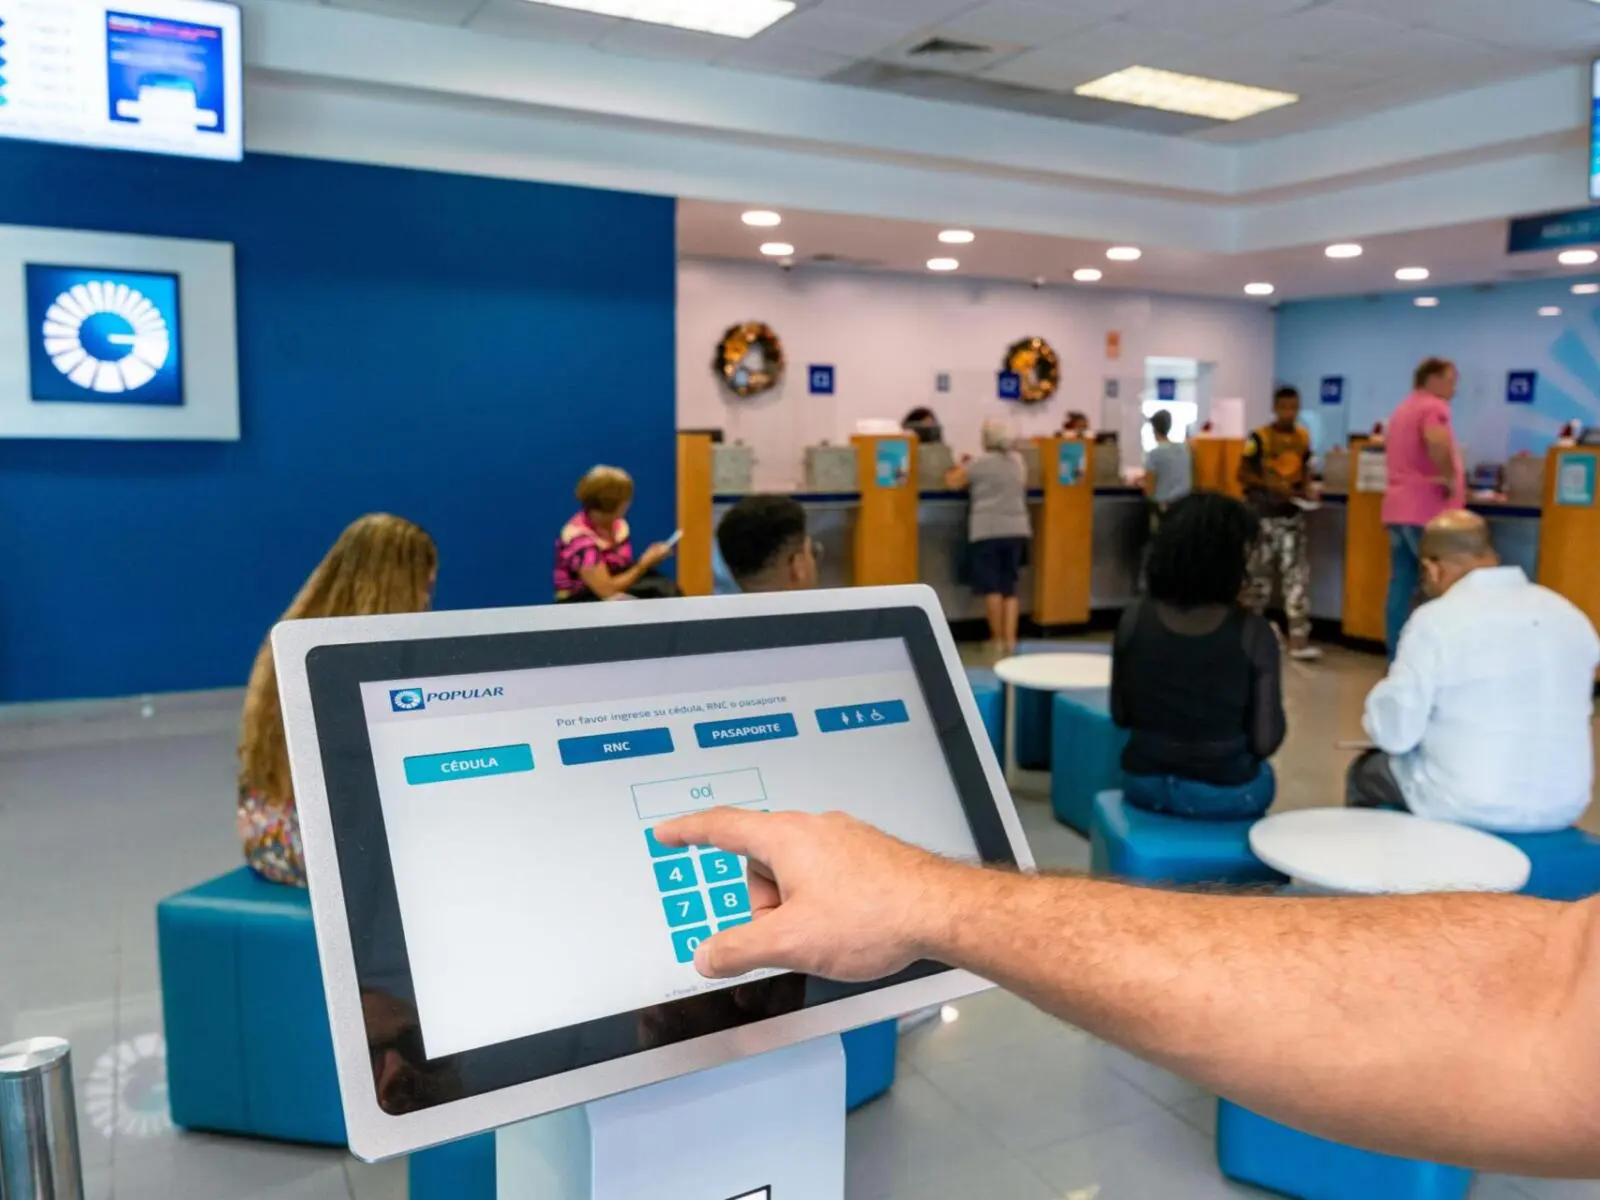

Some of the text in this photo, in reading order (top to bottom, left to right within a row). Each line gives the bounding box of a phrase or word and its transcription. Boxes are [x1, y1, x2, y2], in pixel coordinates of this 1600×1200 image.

[427, 686, 504, 703] POPULAR
[556, 717, 575, 727] Por
[579, 714, 607, 725] favor
[610, 709, 651, 722] ingrese
[706, 700, 728, 710] RNC
[739, 695, 787, 708] pasaporte
[712, 722, 781, 740] PASAPORTE
[603, 741, 631, 753] RNC
[440, 756, 499, 773] CÉDULA
[669, 867, 683, 882] 4
[714, 858, 728, 874] 5
[723, 892, 738, 908] 8
[676, 901, 690, 918] 7
